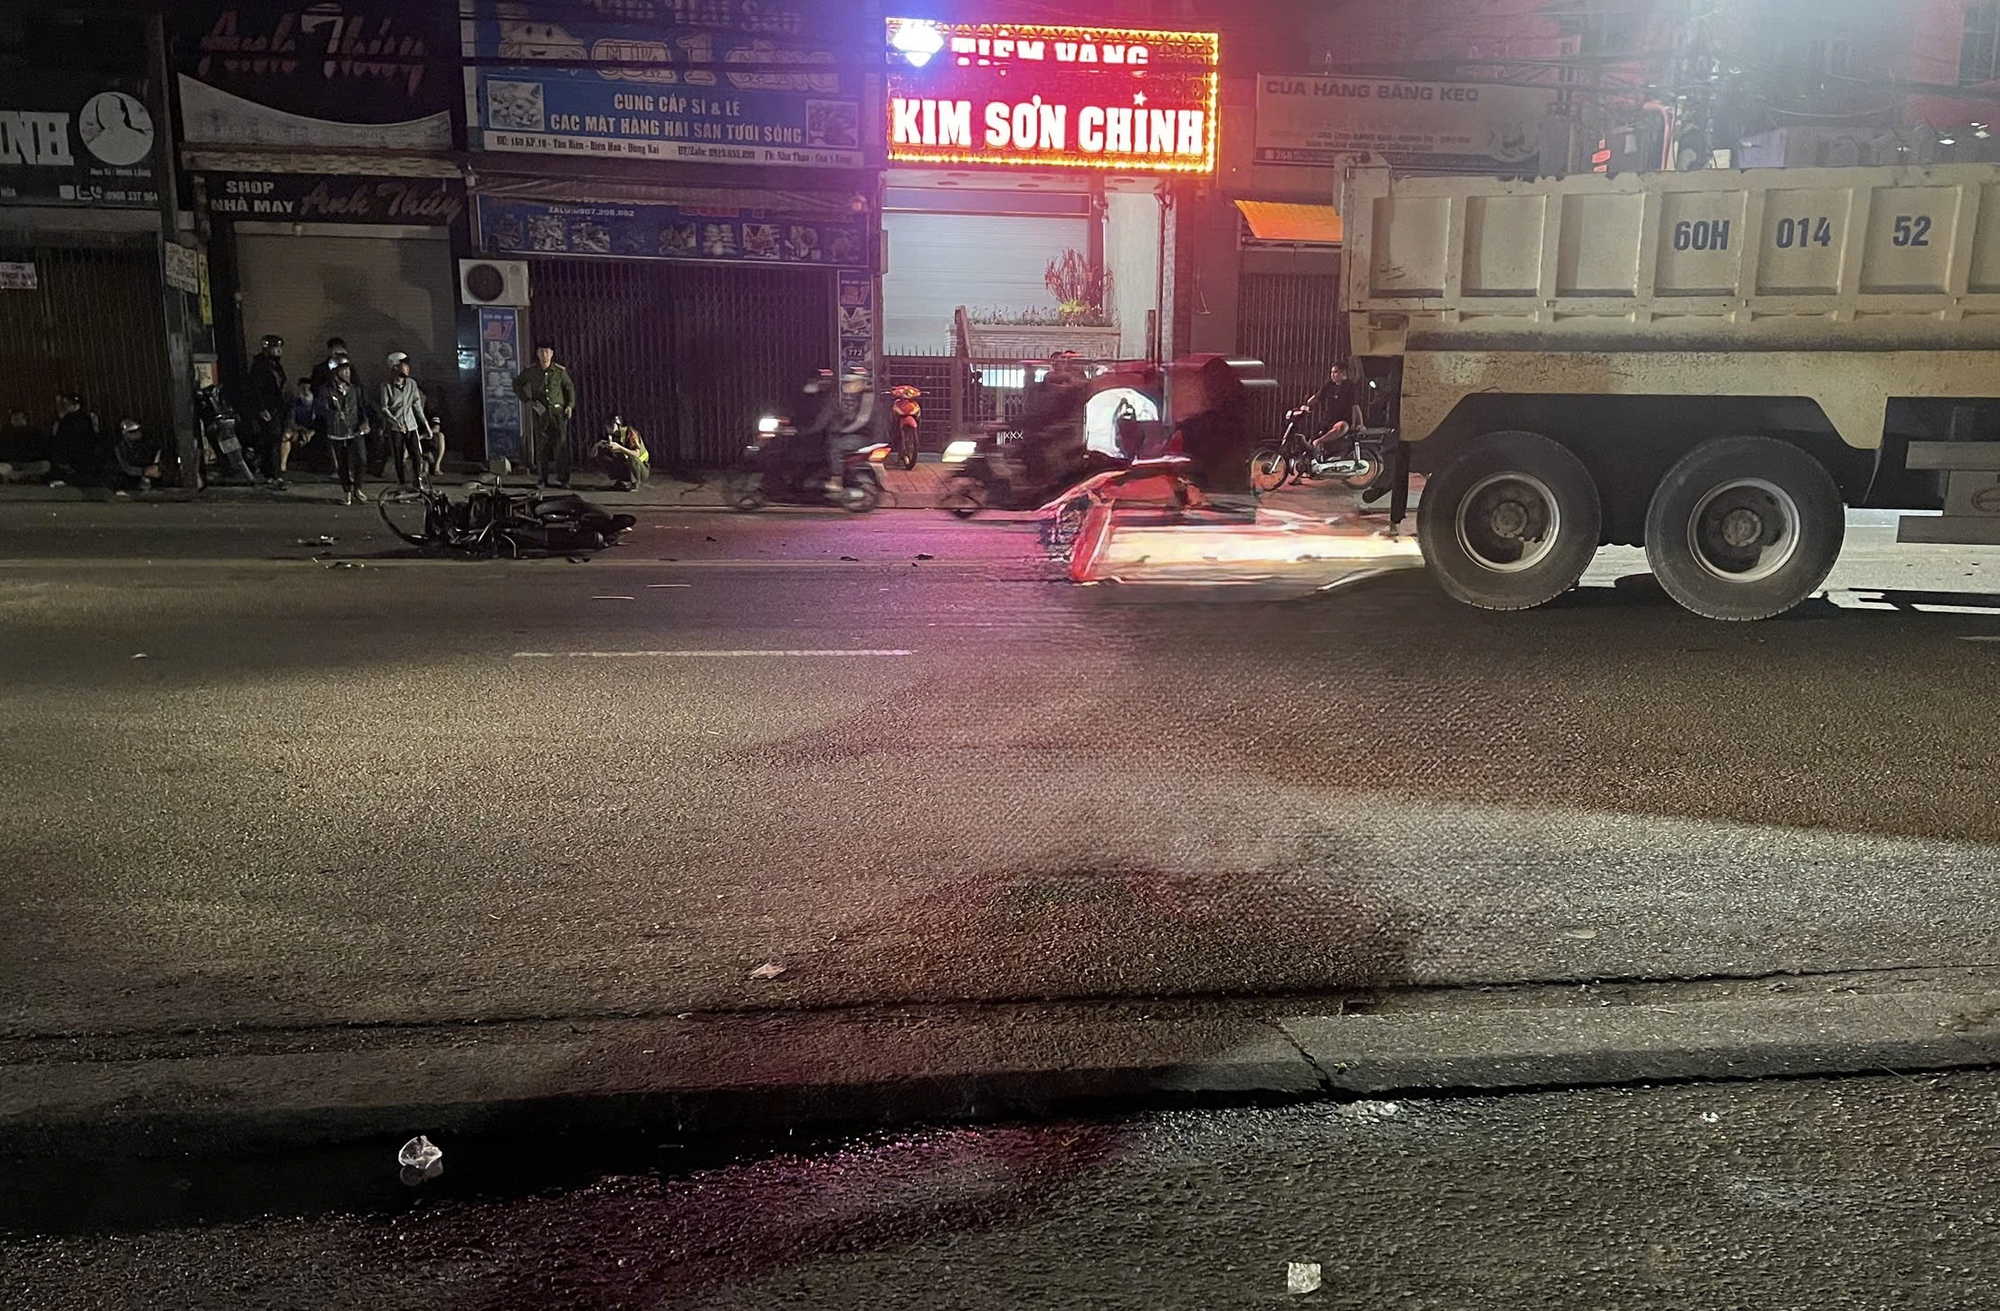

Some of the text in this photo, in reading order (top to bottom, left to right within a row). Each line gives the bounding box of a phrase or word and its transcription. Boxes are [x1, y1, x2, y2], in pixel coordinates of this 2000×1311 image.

[613, 93, 654, 112] CUNG
[711, 101, 722, 116] &
[893, 97, 972, 146] KIM
[985, 94, 1068, 150] SƠN
[0, 111, 75, 167] NH
[226, 180, 275, 195] SHOP
[210, 196, 294, 214] NHÀ MAY
[1673, 215, 1932, 252] 60H 014 52
